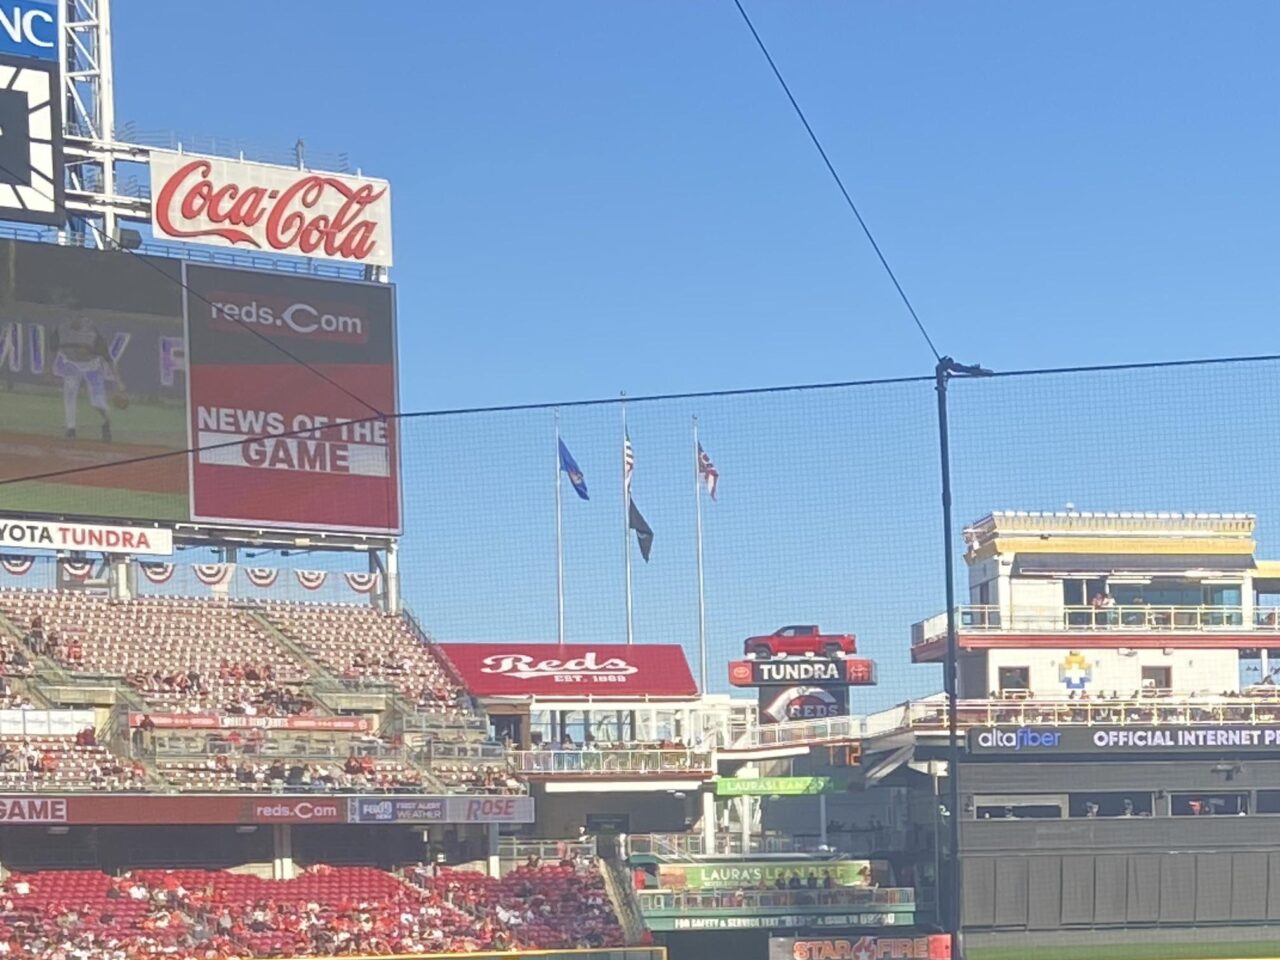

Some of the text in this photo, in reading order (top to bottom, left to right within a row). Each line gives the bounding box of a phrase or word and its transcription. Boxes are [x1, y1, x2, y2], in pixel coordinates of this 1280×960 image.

[156, 160, 387, 260] Coca-Cola
[197, 405, 388, 444] NEWS OF THE
[241, 438, 351, 473] GAME
[58, 527, 151, 549] TUNDRA
[480, 652, 639, 679] Reds
[759, 663, 840, 681] TUNDRA
[789, 704, 839, 718] REDS
[978, 728, 1062, 751] altafiber
[1093, 730, 1175, 747] OFFICIAL
[1177, 730, 1261, 746] INTERNET
[397, 809, 442, 819] WEATHER
[466, 799, 515, 822] ROSE
[700, 868, 762, 881] LAURA'S
[792, 936, 929, 960] STAR FIRE
